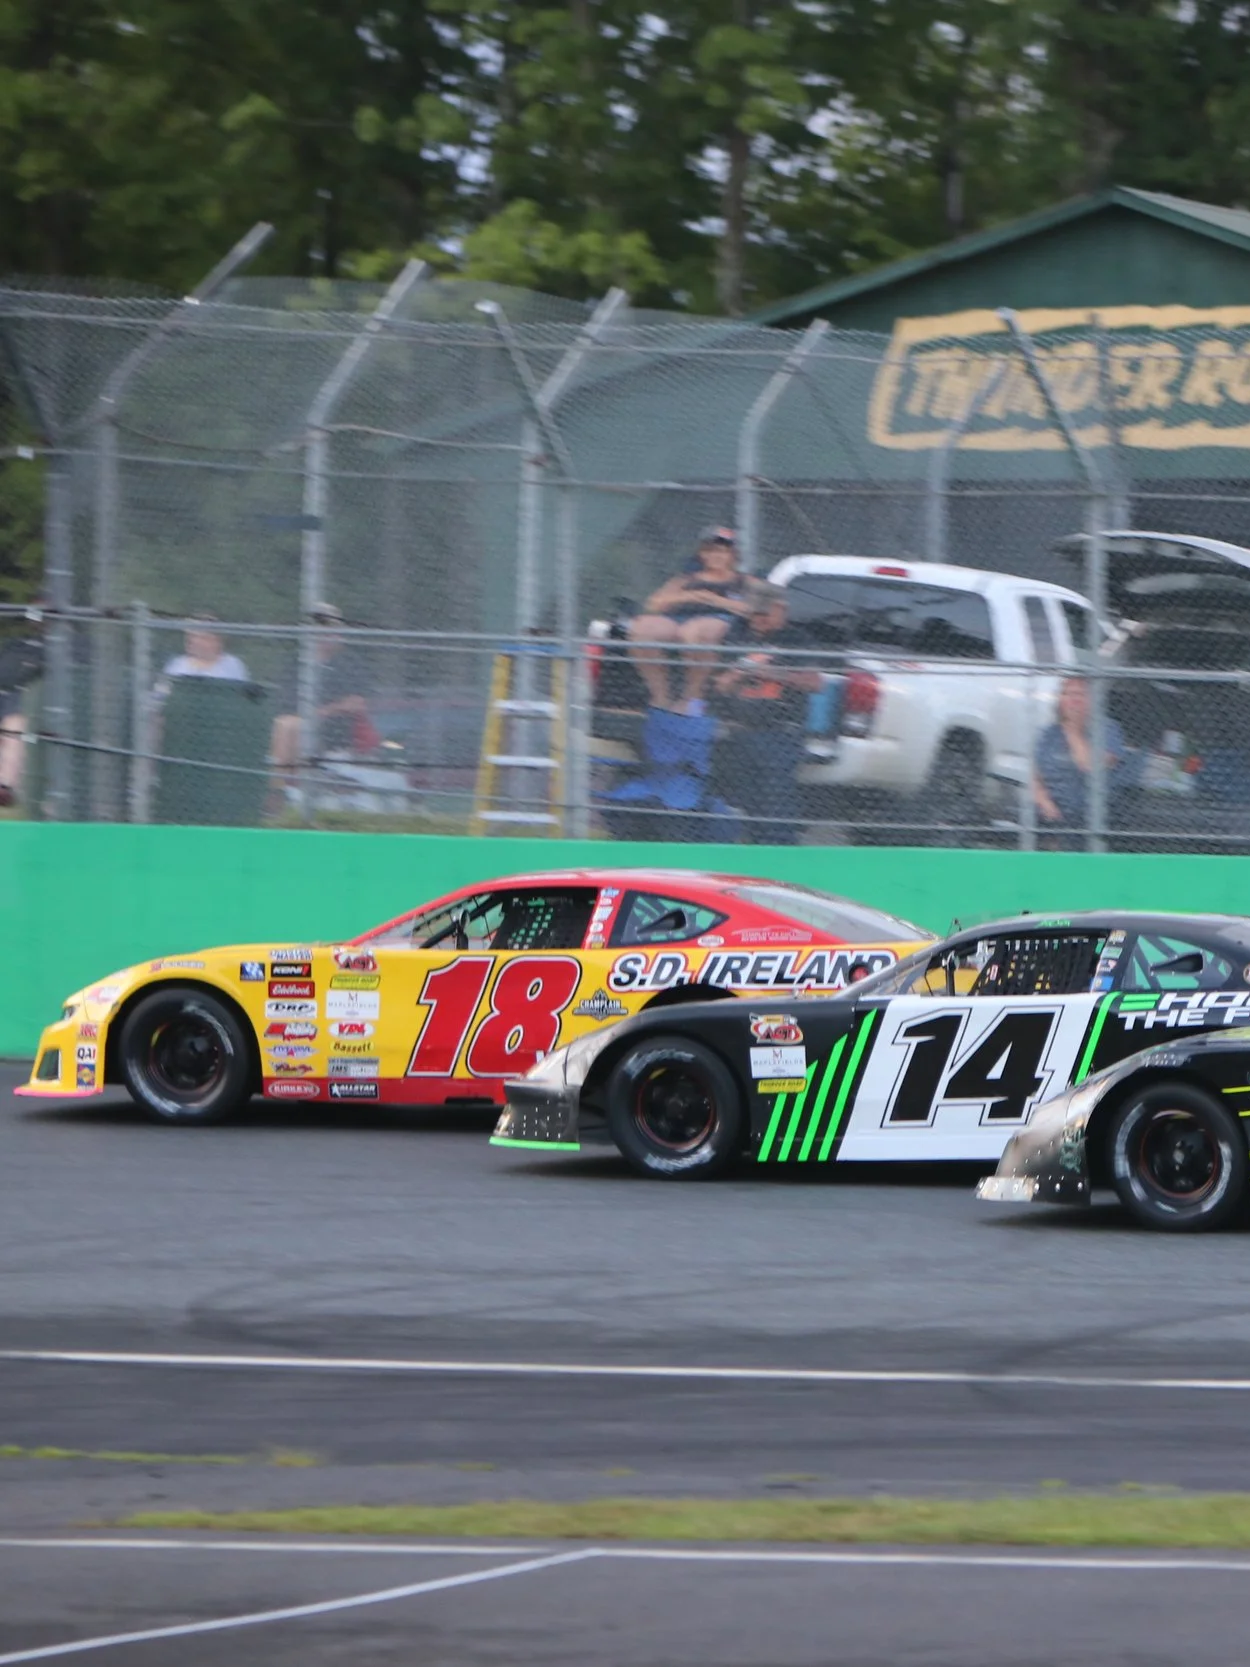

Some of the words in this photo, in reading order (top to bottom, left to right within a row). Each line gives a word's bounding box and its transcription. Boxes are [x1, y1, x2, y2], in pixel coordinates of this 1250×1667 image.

[611, 953, 694, 989] S.D.
[701, 951, 897, 989] IRELAND
[404, 956, 582, 1078] 18
[1118, 1007, 1201, 1031] THE
[880, 1005, 1064, 1128] 14
